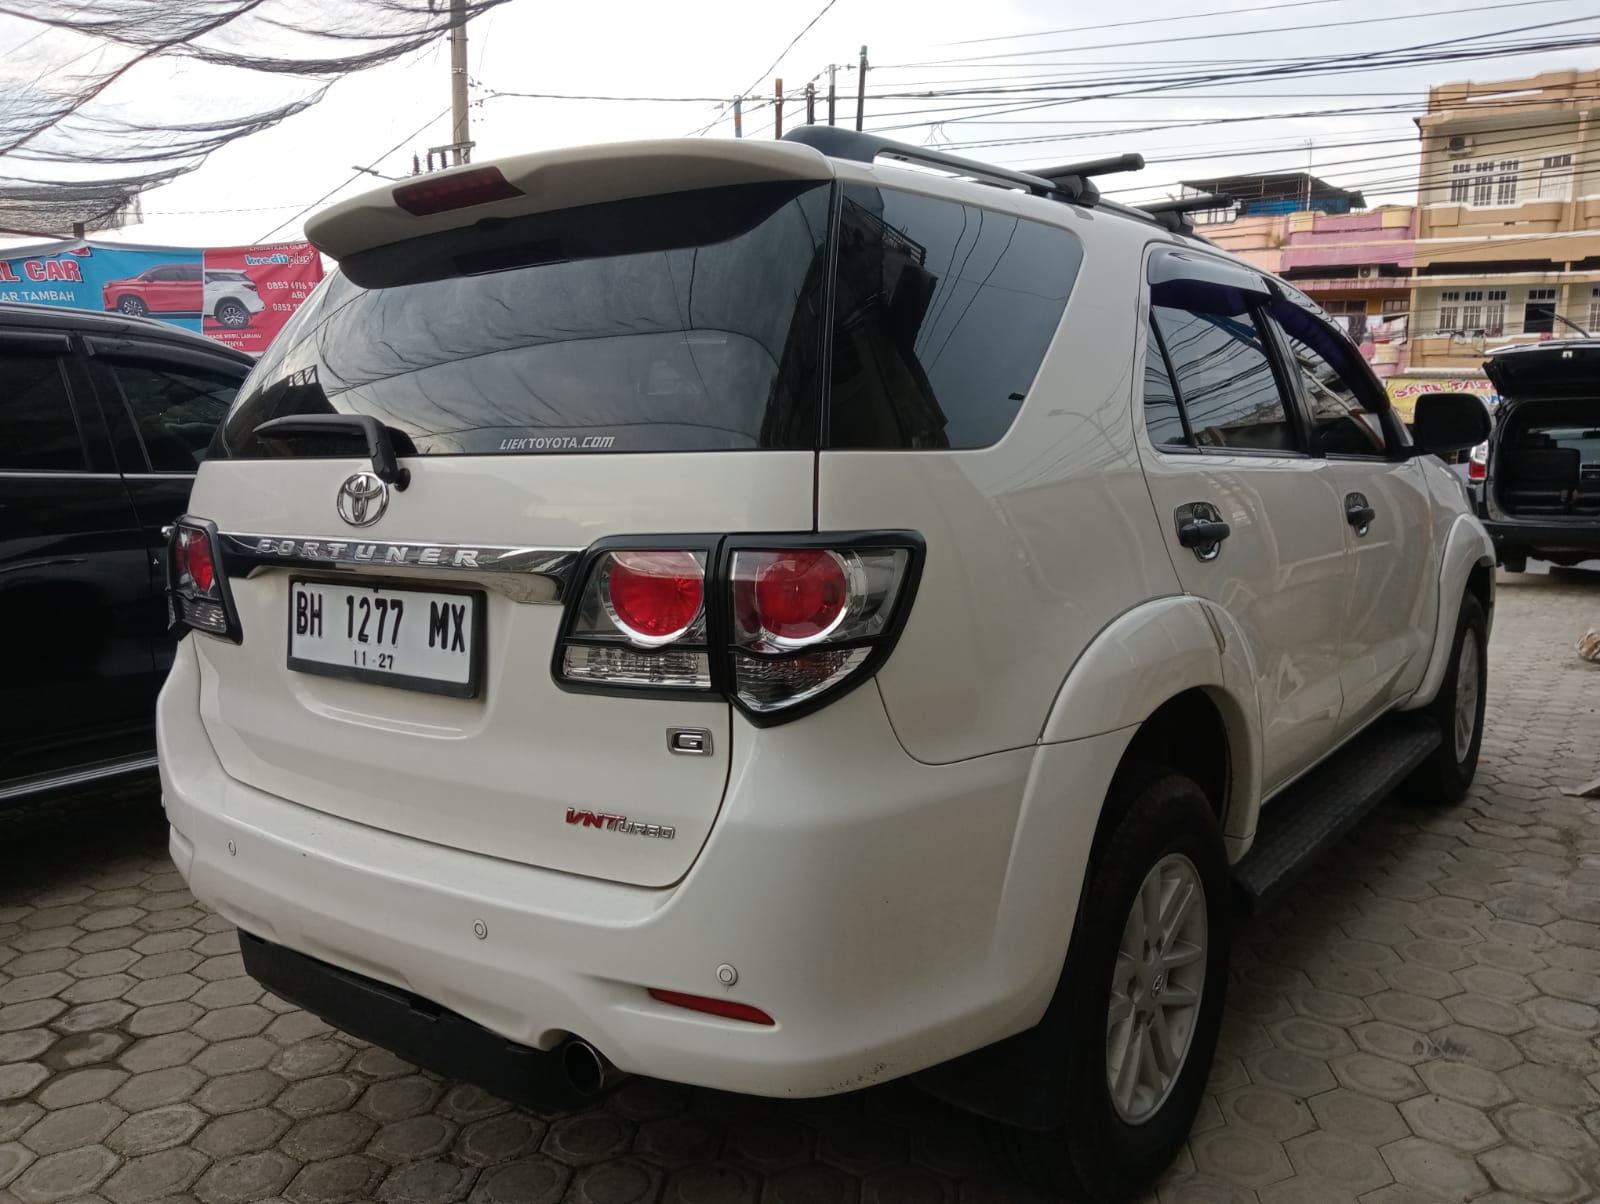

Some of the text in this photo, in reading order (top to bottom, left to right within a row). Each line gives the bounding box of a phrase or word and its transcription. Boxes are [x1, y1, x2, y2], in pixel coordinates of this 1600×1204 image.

[24, 259, 82, 282] CAR
[21, 290, 75, 302] TAMBAH
[266, 281, 289, 290] 0853
[256, 539, 480, 567] FORTUNER
[295, 591, 466, 653] BH 1277 MX
[671, 731, 704, 754] G
